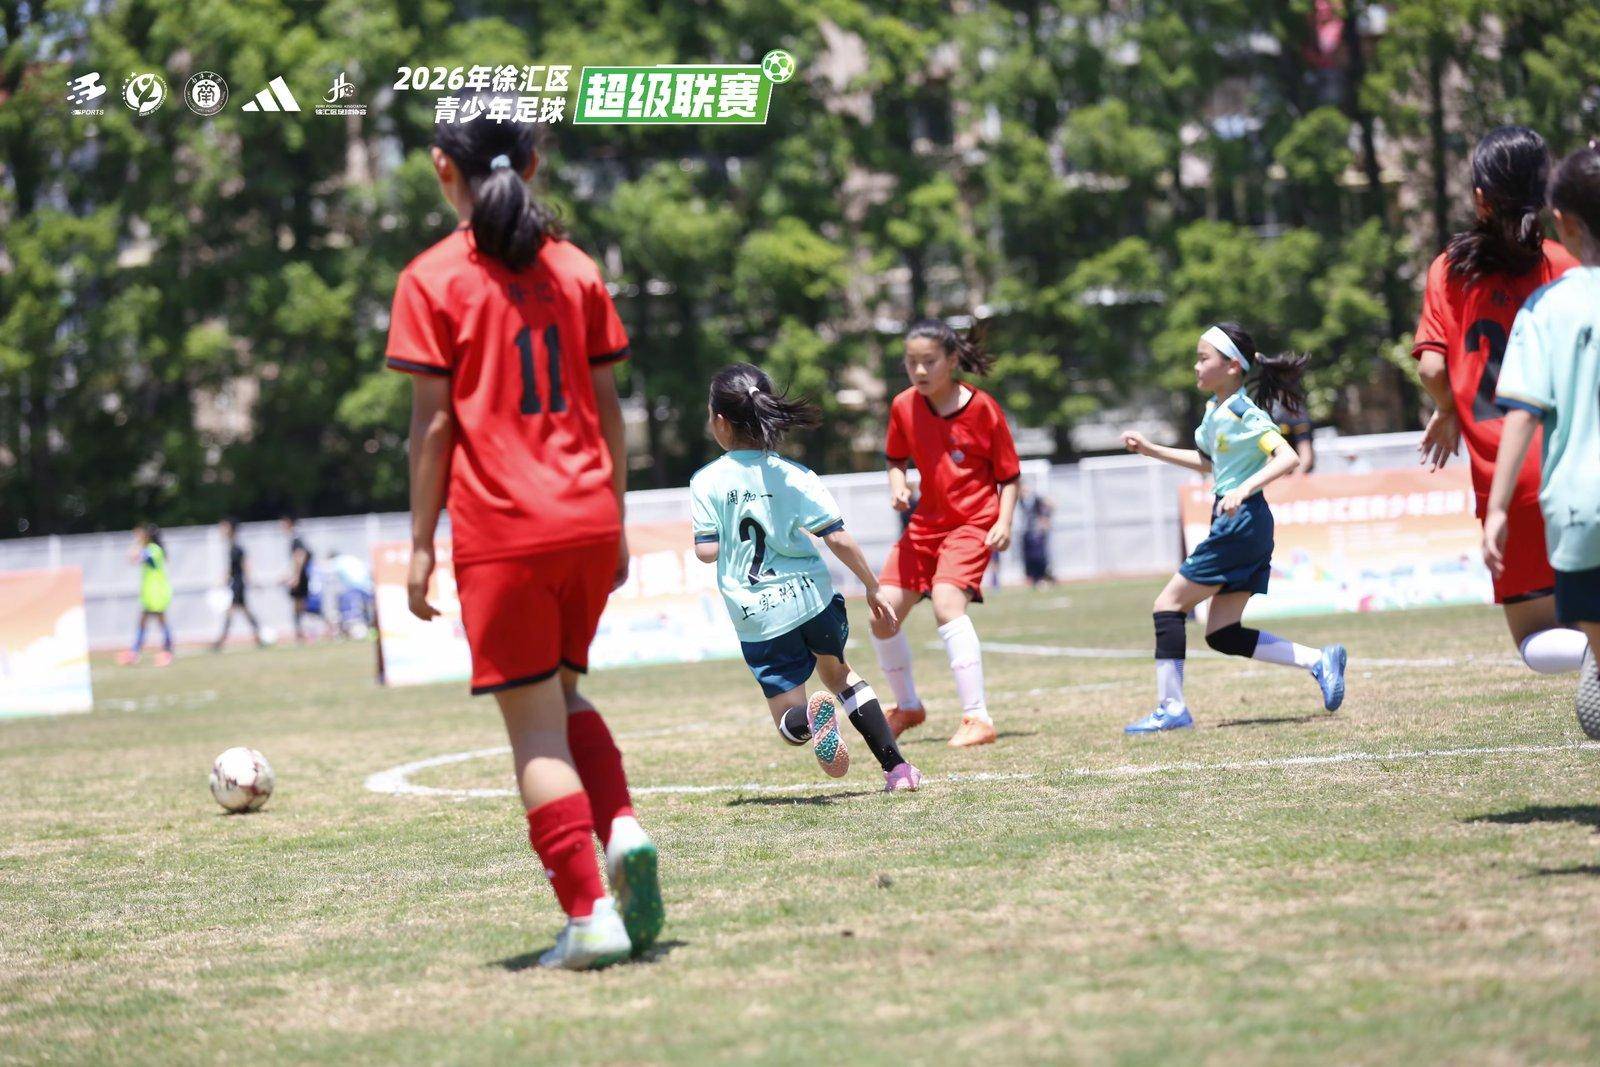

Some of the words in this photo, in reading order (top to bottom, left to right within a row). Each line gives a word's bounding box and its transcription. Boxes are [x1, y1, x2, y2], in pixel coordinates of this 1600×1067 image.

[514, 324, 567, 414] 11
[727, 489, 773, 506] 周加一
[739, 517, 777, 586] 2
